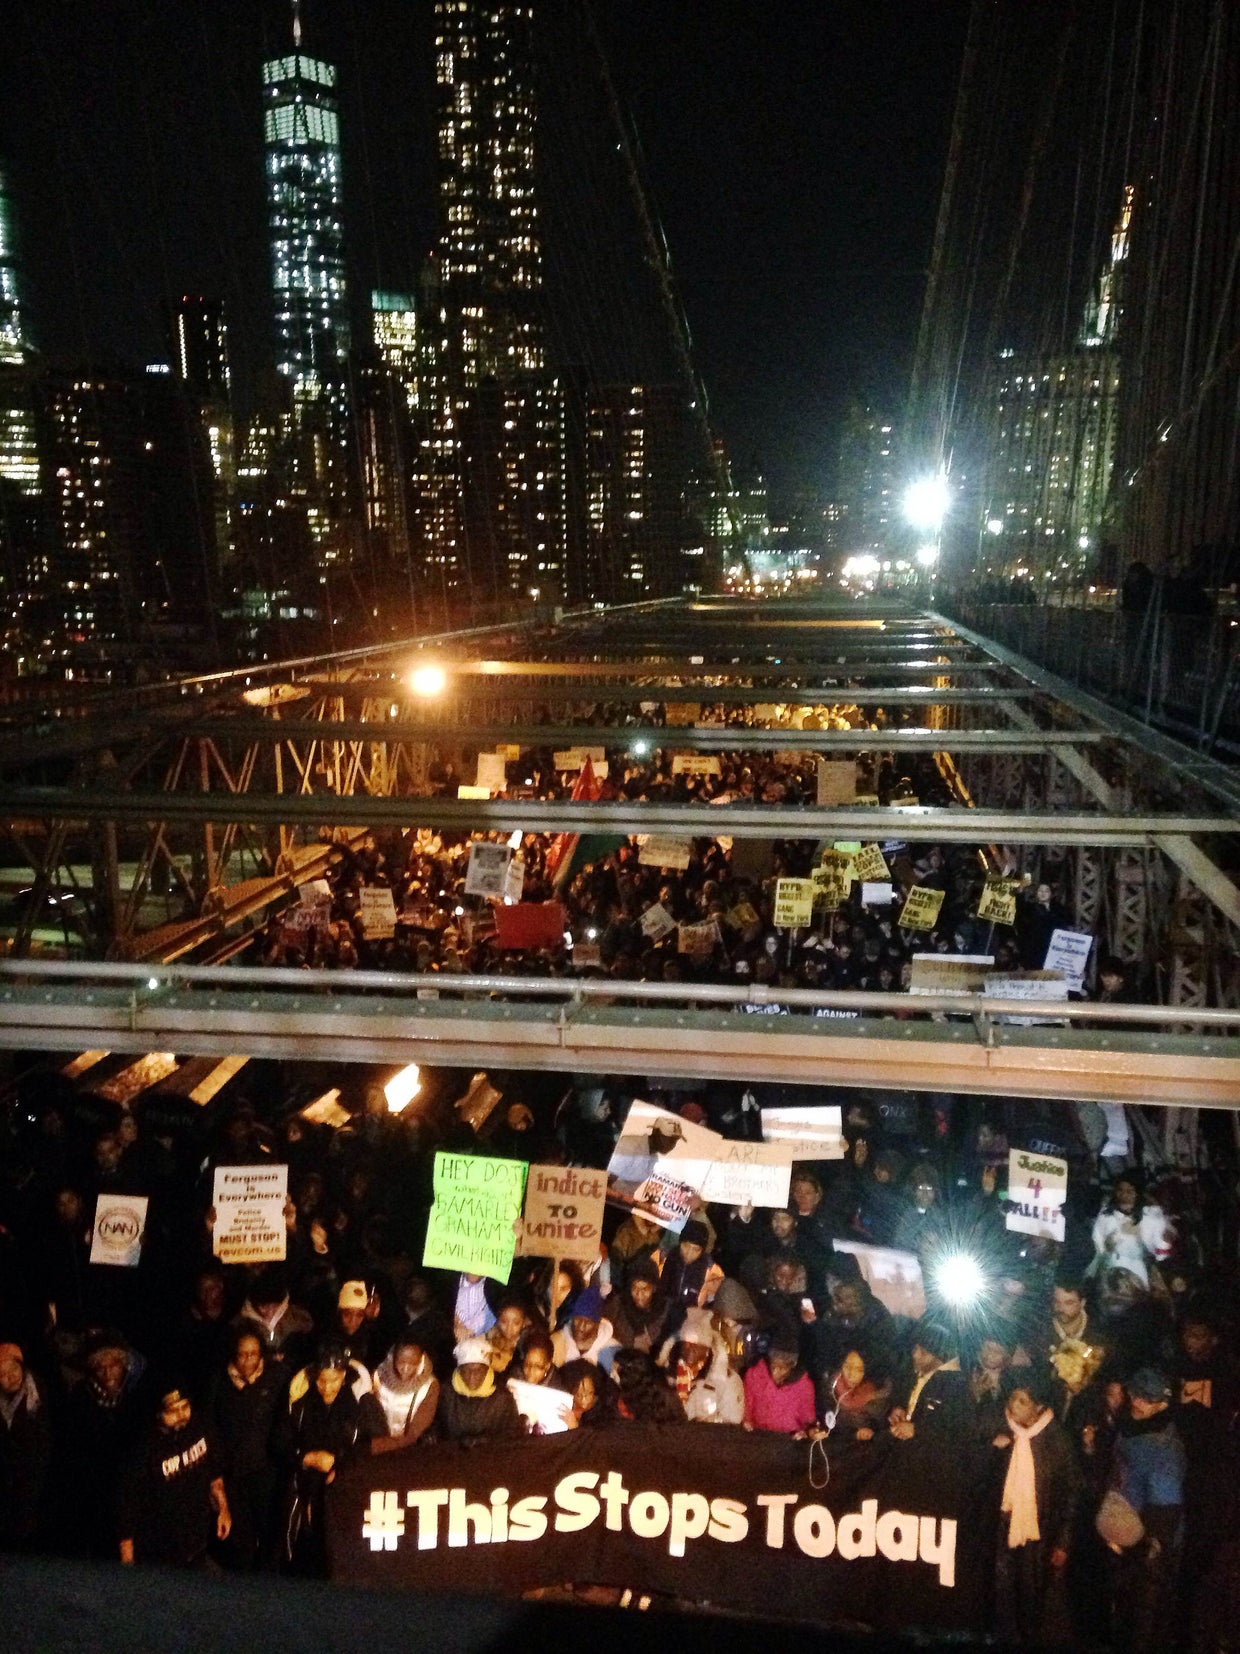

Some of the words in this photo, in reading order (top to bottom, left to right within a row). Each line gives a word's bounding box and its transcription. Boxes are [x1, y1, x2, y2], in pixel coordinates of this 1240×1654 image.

[440, 1158, 474, 1181] HEY
[1017, 1154, 1066, 1178] Justice
[224, 1174, 278, 1185] Ferguson
[1027, 1177, 1042, 1199] 4
[218, 1192, 282, 1203] Everywhere
[643, 1191, 661, 1204] NO
[662, 1199, 688, 1216] GUN
